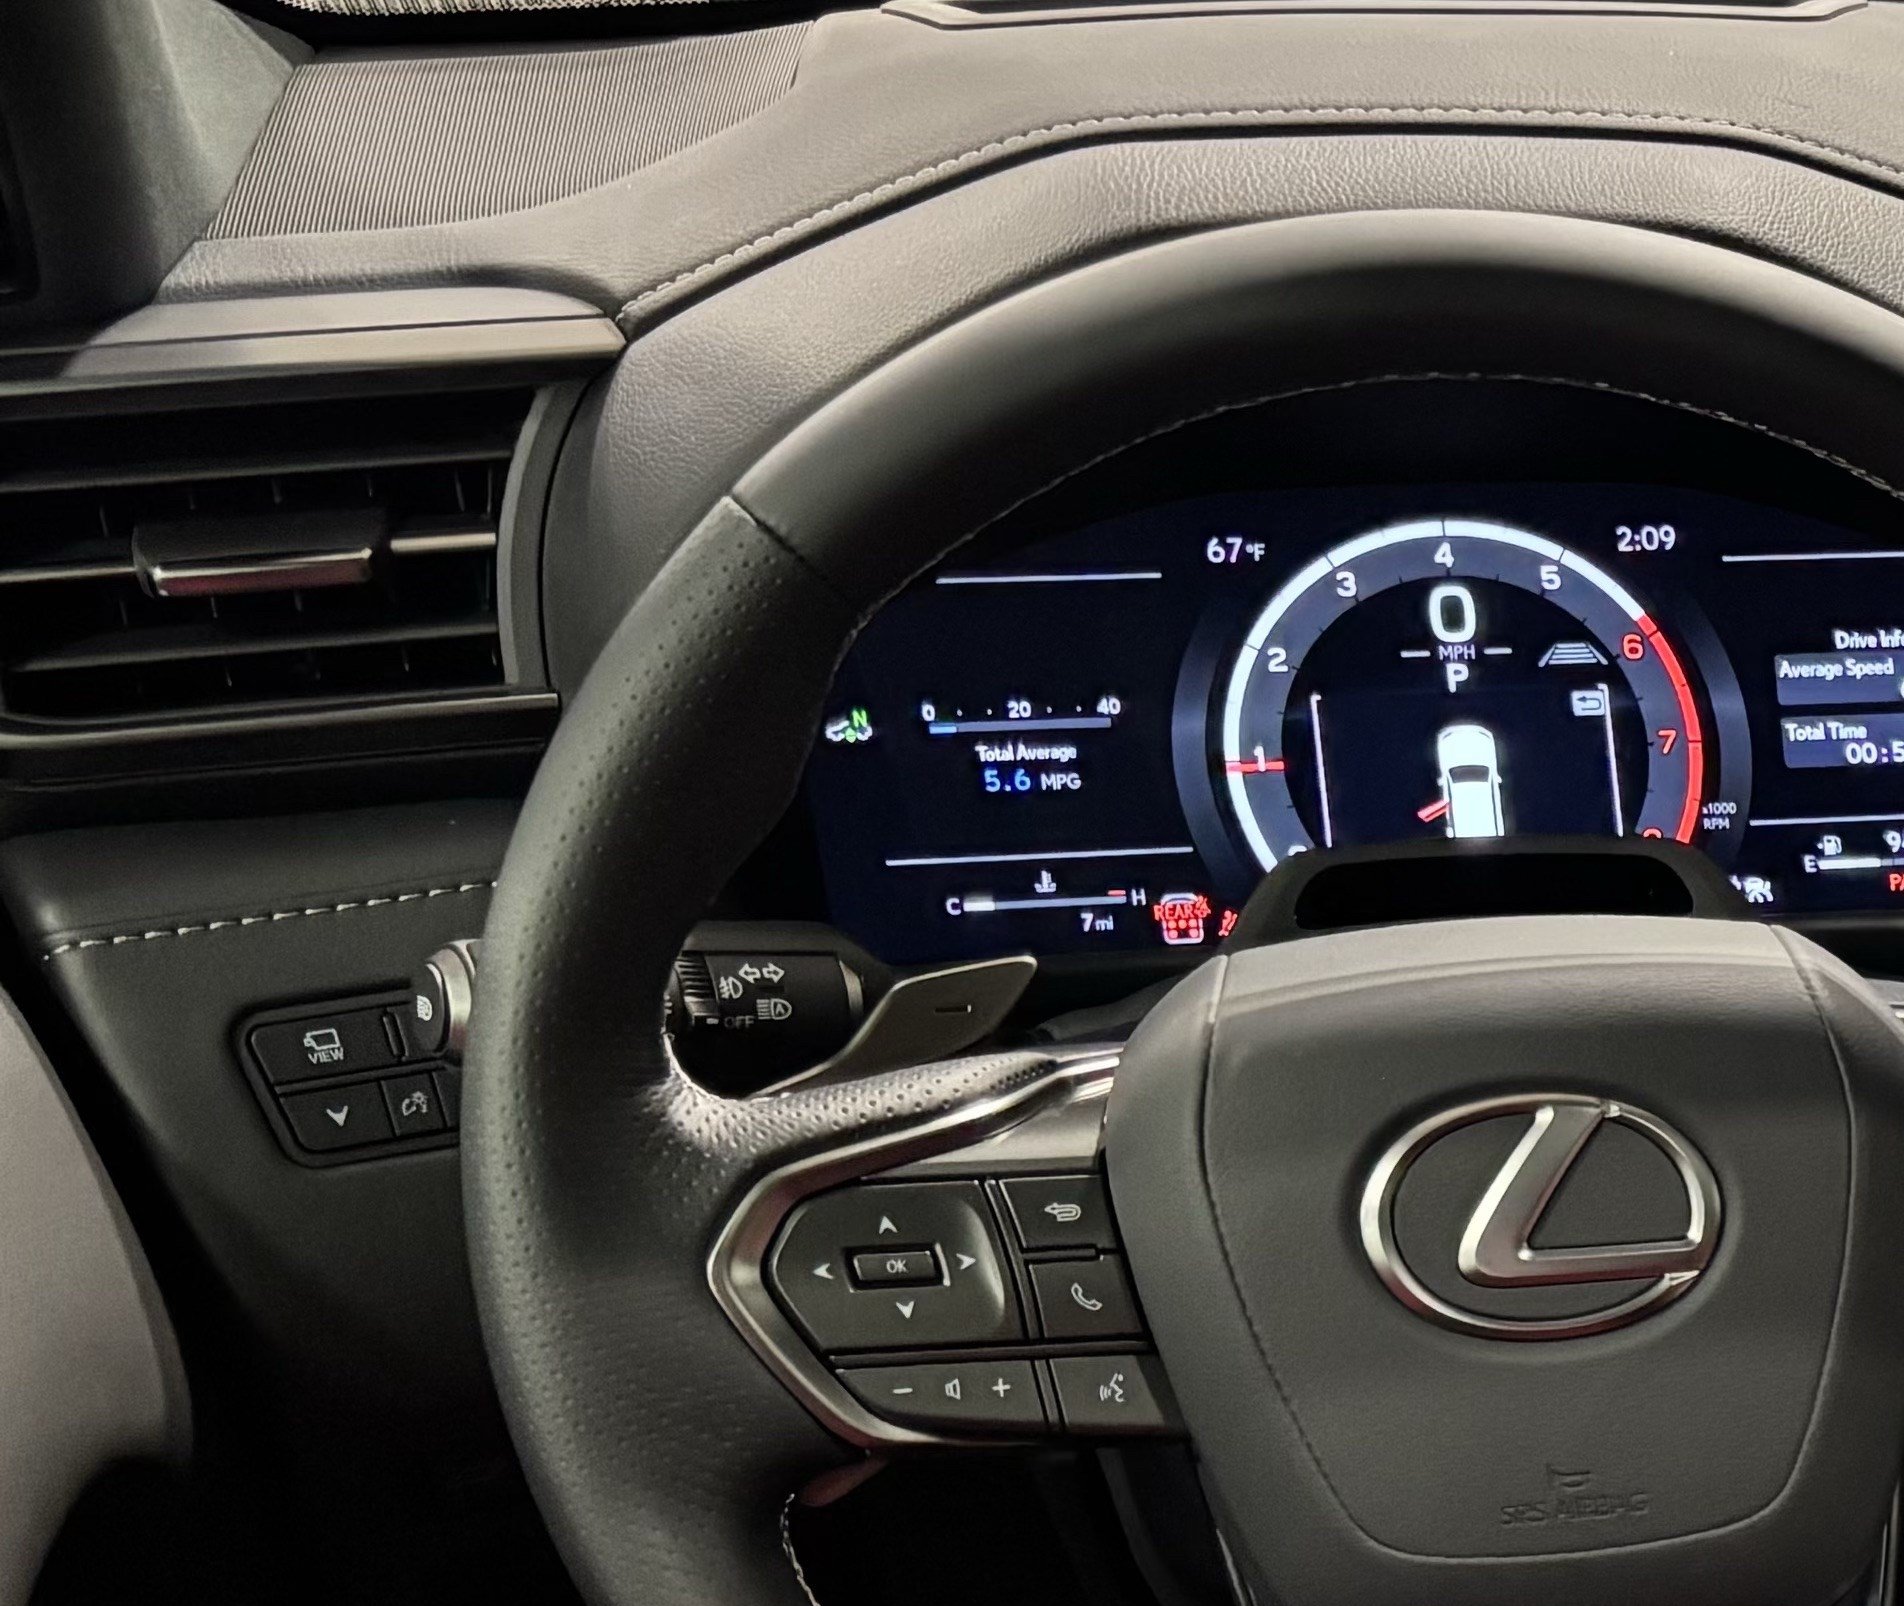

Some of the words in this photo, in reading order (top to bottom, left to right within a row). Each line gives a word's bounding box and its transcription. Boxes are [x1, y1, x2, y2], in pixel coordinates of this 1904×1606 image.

[1616, 525, 1675, 552] 2:09
[1433, 542, 1455, 568] 4
[1337, 572, 1356, 597] 3
[1540, 566, 1562, 590] 5
[1430, 585, 1475, 642] 0
[1623, 635, 1643, 659] 6
[1834, 631, 1875, 649] Drive
[1267, 648, 1288, 673] 2
[1438, 645, 1476, 660] MPH
[1447, 665, 1469, 692] P
[1780, 662, 1842, 681] Average
[1845, 659, 1894, 678] Speed
[922, 704, 935, 722] 0
[1007, 701, 1032, 719] 20
[1097, 698, 1121, 716] 40
[1658, 730, 1677, 753] 7
[1786, 723, 1824, 741] Total
[1827, 722, 1867, 739] Time
[975, 745, 1014, 762] Total
[1016, 744, 1077, 762] Average
[984, 768, 1032, 793] 5.6
[1041, 773, 1081, 791] MPG
[1704, 817, 1730, 829] RPM
[1804, 855, 1817, 873] E
[945, 898, 961, 916] C
[1131, 889, 1146, 906] H
[724, 1016, 755, 1029] OFF
[309, 1046, 344, 1065] VIEW
[886, 1259, 907, 1272] OK
